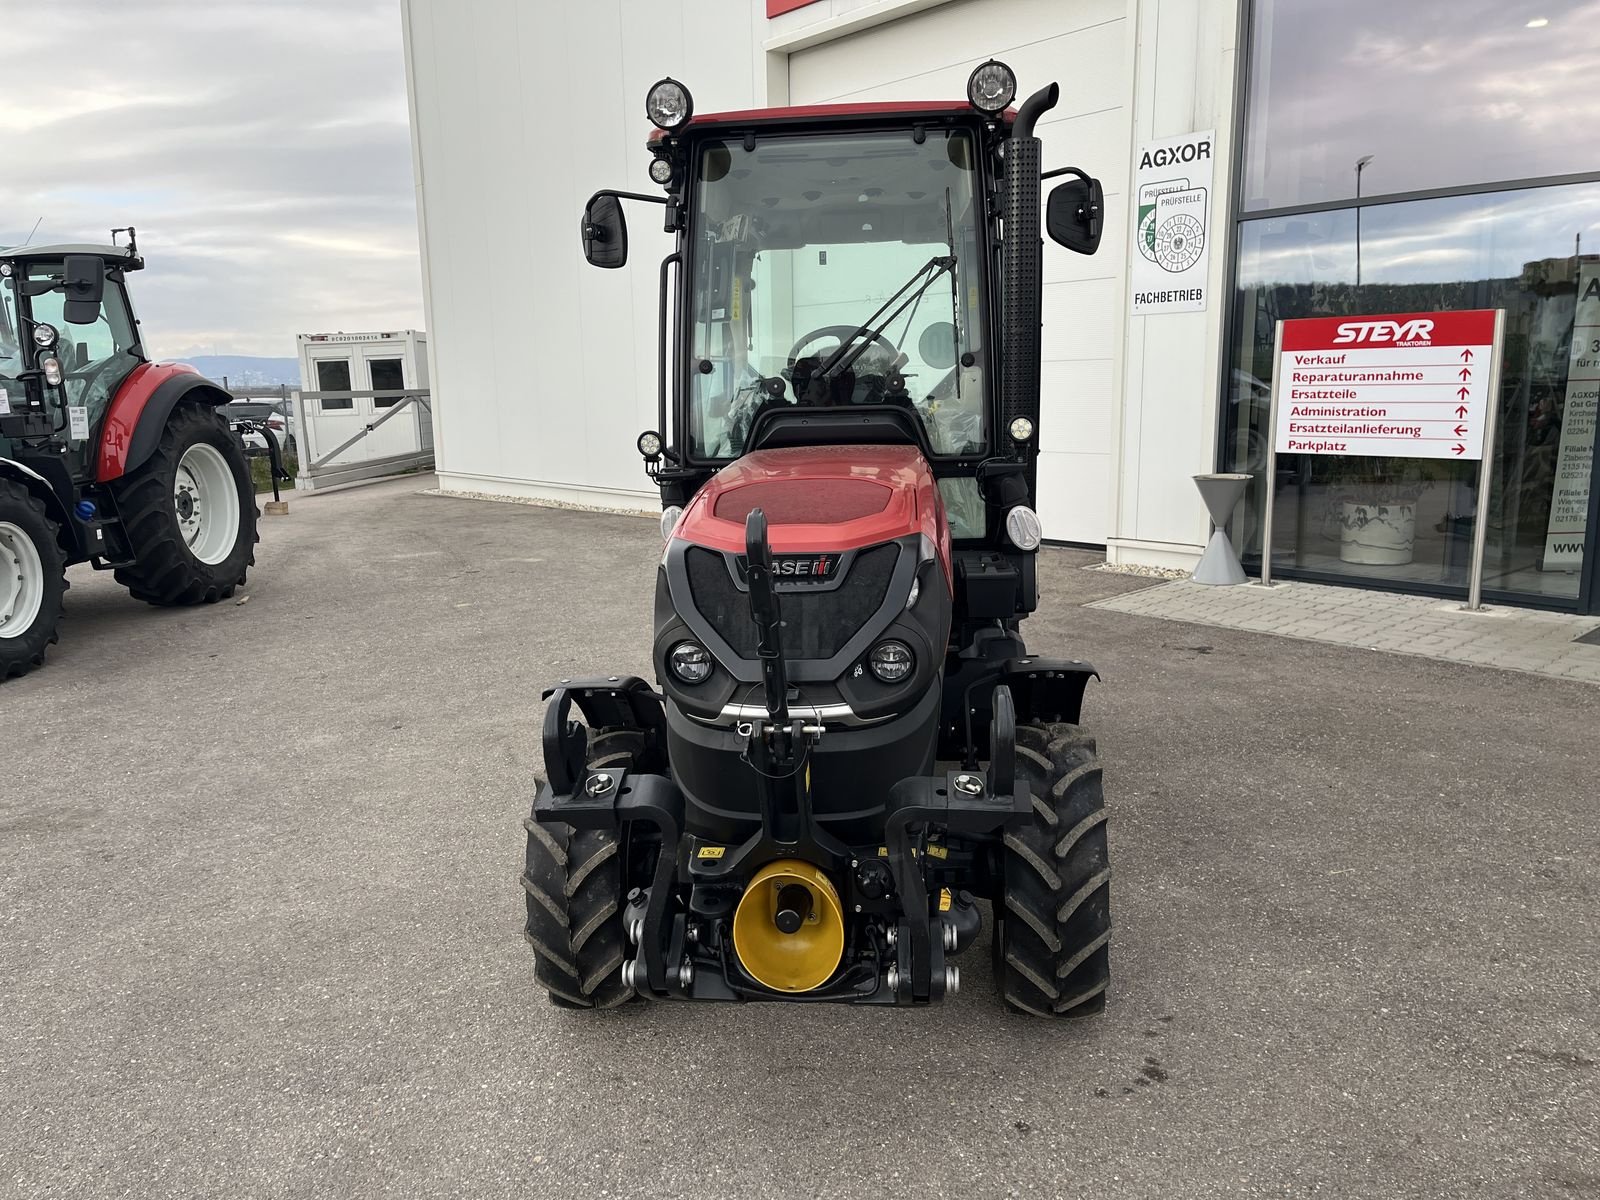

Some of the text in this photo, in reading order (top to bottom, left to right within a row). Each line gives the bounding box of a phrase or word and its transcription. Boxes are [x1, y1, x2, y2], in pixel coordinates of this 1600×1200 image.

[1139, 141, 1211, 170] AGXOR
[1160, 193, 1201, 206] PRÜFSTELLE
[1134, 288, 1203, 305] FACHBETRIEB
[1333, 319, 1435, 343] STEYR
[1295, 354, 1346, 365] Verkauf
[1292, 371, 1424, 385] Reparaturannahme
[1291, 389, 1357, 399] Ersatzteile
[1291, 406, 1387, 417] Administration
[1289, 423, 1422, 437] Ersatzteilanlieferung
[1288, 440, 1347, 453] Parkplatz
[771, 560, 810, 575] ASE
